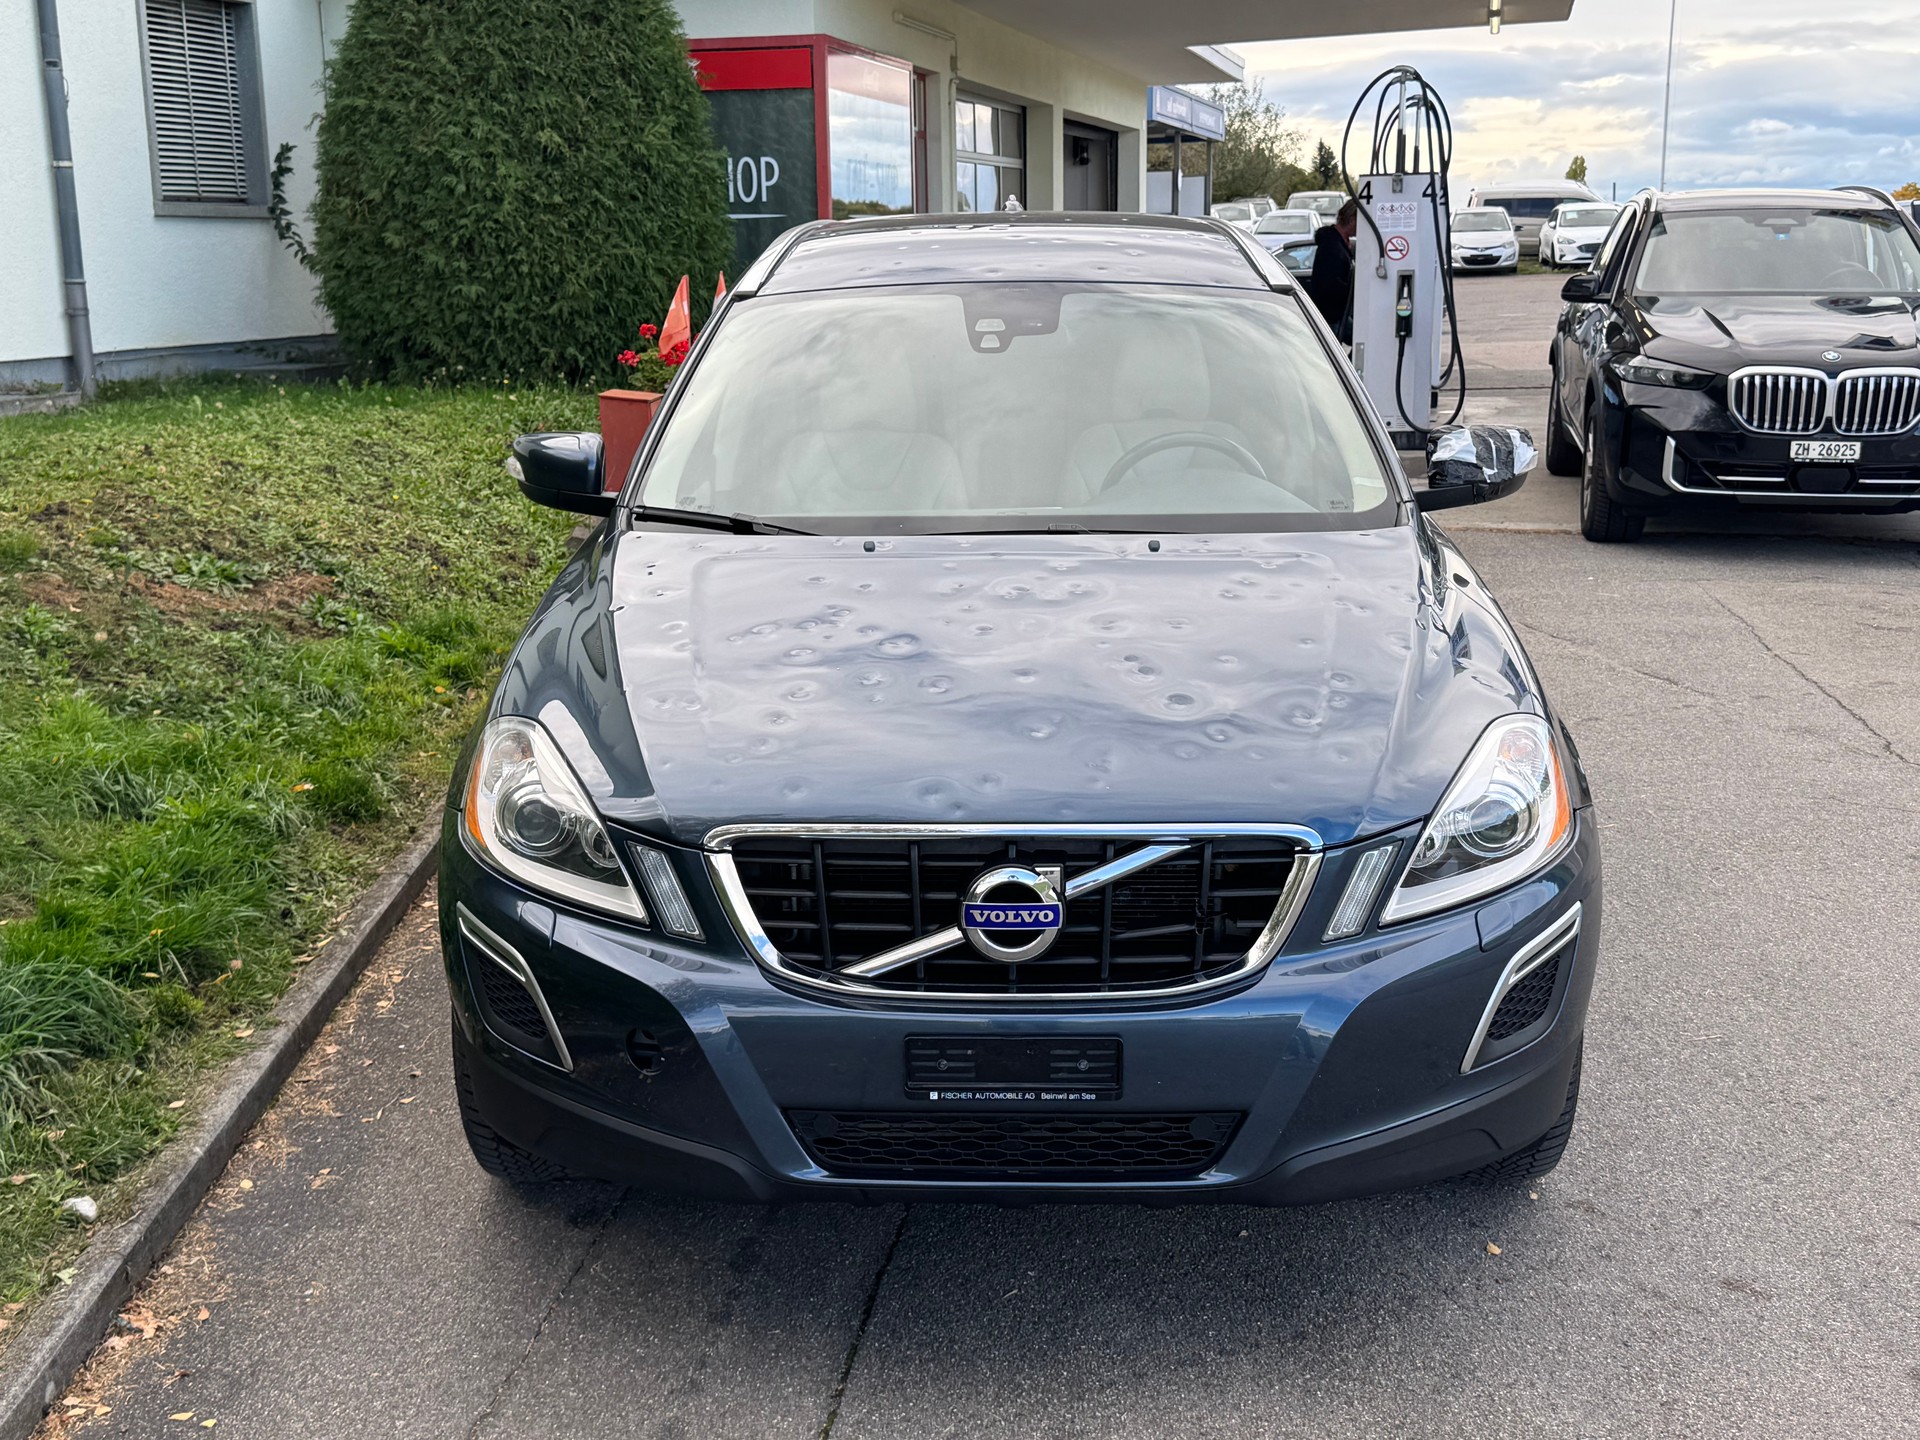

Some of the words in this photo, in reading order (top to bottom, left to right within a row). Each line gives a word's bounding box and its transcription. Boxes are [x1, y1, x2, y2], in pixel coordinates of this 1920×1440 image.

[1358, 181, 1373, 205] 4
[970, 910, 1054, 922] VOLVO
[941, 1092, 973, 1100] FISCHER
[975, 1092, 1023, 1100] AUTOMOBILE
[1025, 1092, 1036, 1100] AG
[1041, 1092, 1068, 1100] Beinwil
[1081, 1092, 1097, 1100] See
